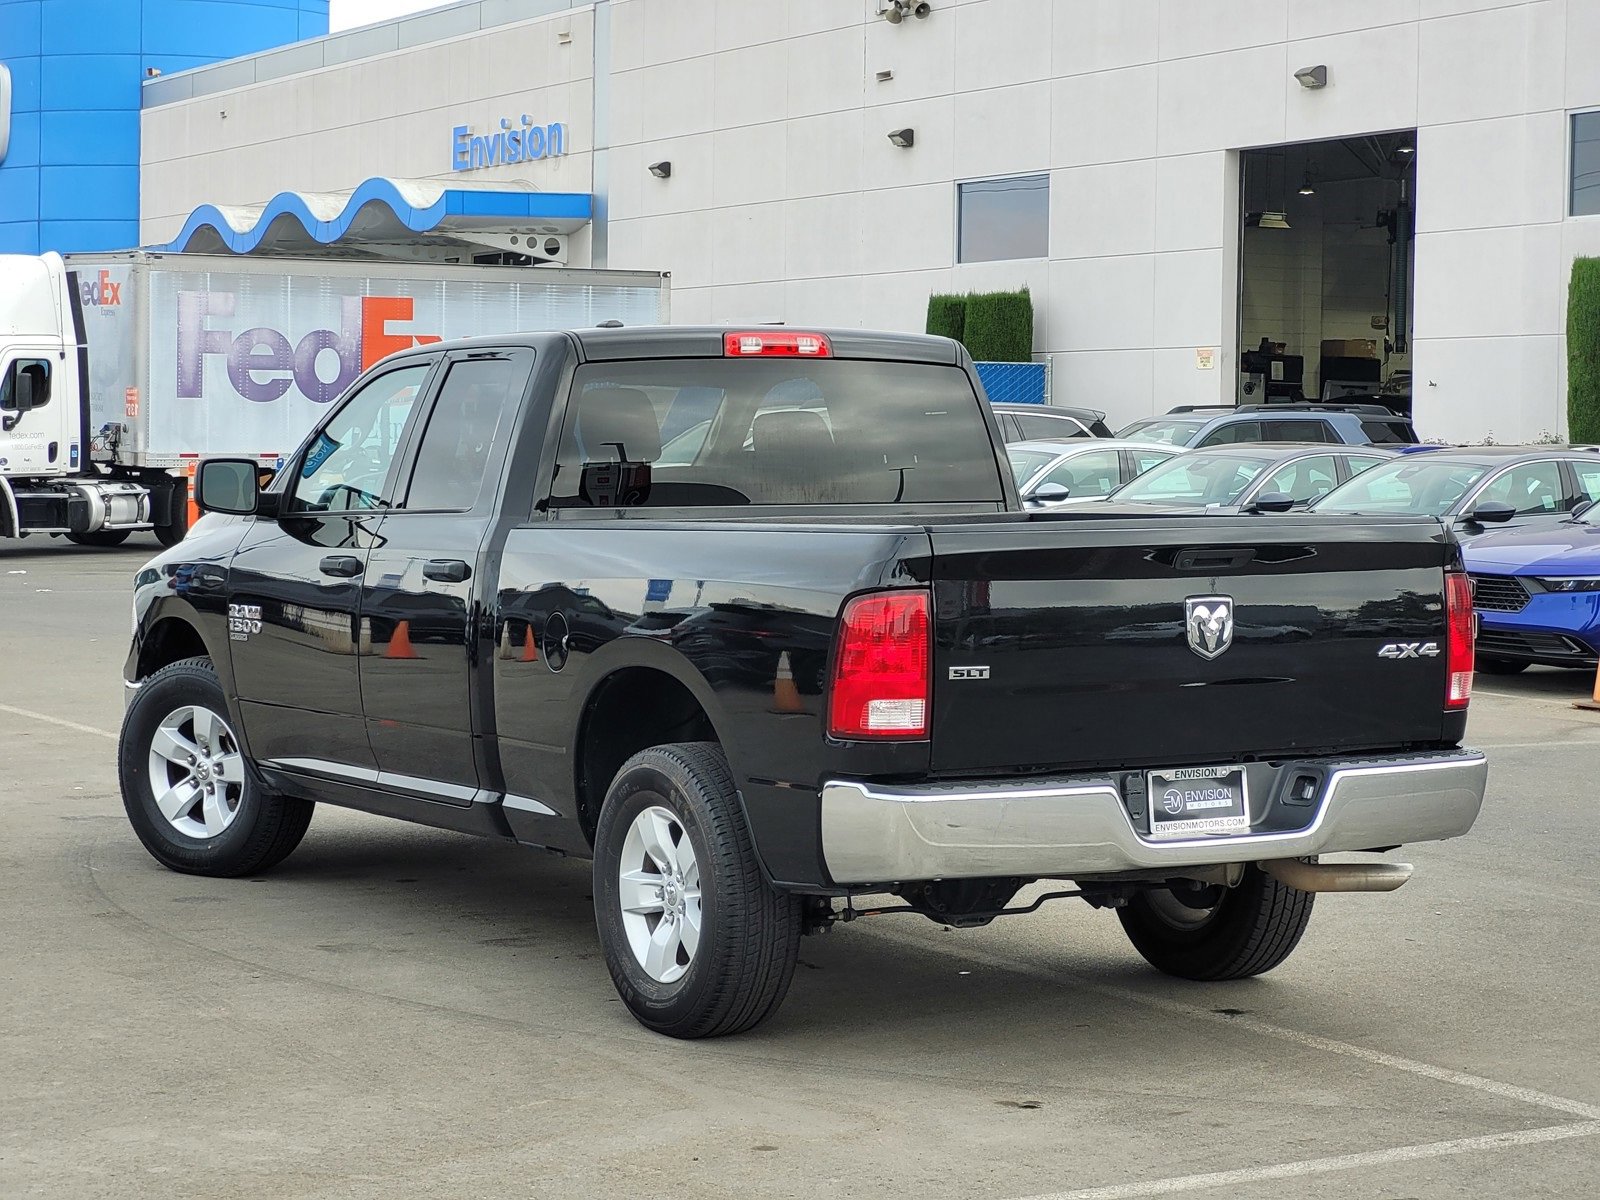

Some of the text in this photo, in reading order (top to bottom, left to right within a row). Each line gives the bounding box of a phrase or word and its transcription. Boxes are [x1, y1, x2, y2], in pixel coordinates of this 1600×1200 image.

[452, 113, 567, 171] Envision
[177, 290, 443, 403] FedE
[229, 604, 262, 619] RAM
[229, 618, 262, 634] 1500
[951, 668, 988, 679] SLT
[1174, 768, 1218, 779] ENVISION
[1185, 788, 1232, 801] ENVISION
[1155, 818, 1245, 832] ENVISIONMOTORS.COM
